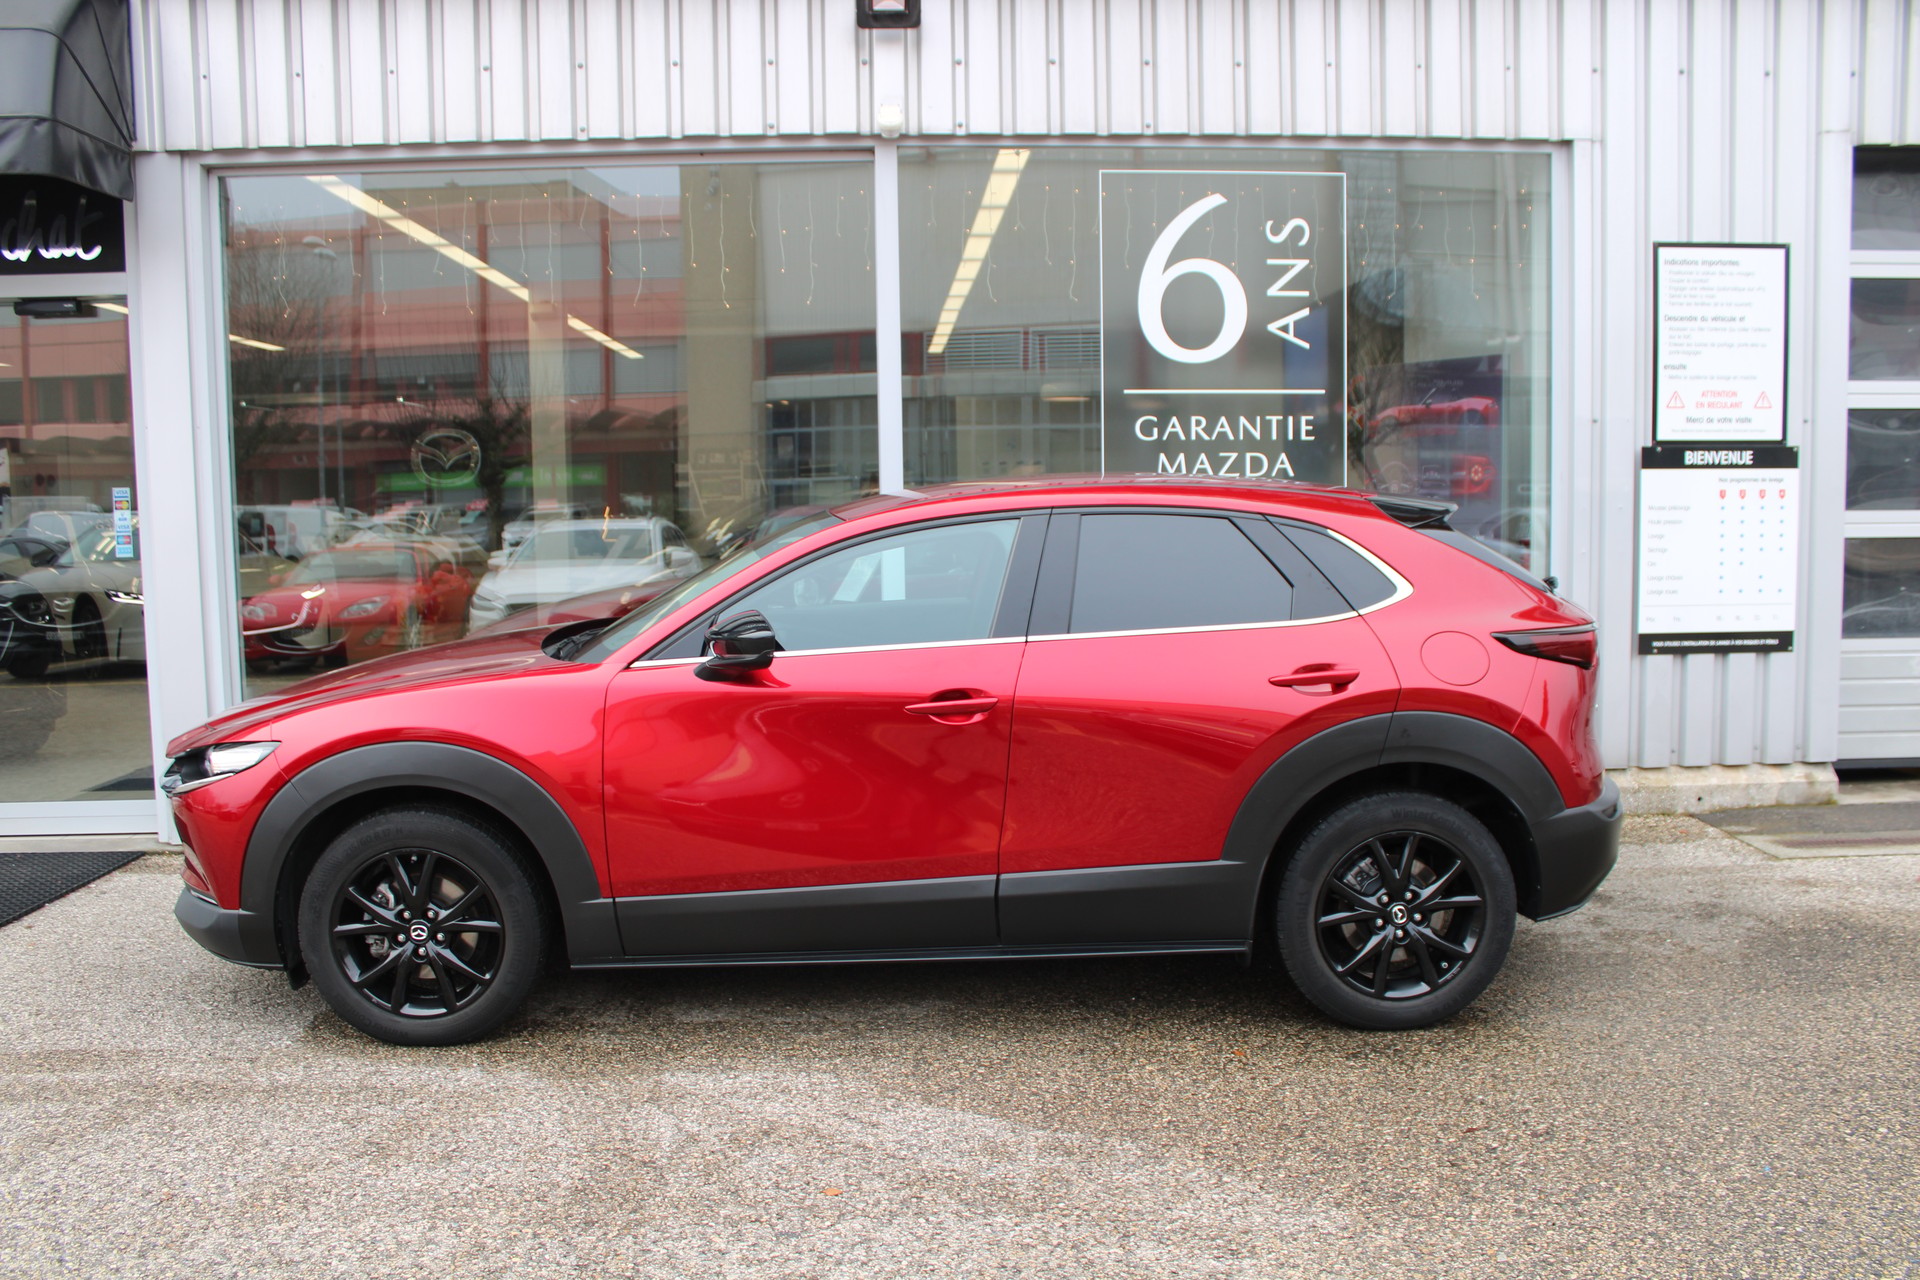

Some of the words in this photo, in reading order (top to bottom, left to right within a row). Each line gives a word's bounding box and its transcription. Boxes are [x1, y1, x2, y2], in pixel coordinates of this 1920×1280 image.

[1138, 193, 1248, 364] 6
[1265, 217, 1311, 350] ANS
[1664, 314, 1698, 322] Descendre
[1701, 390, 1738, 398] ATTENTION
[1695, 401, 1705, 409] EN
[1707, 401, 1743, 409] RECULANT
[1134, 415, 1316, 441] GARANTIE
[1157, 452, 1295, 477] MAZDA
[1684, 450, 1754, 465] BIENVENUE
